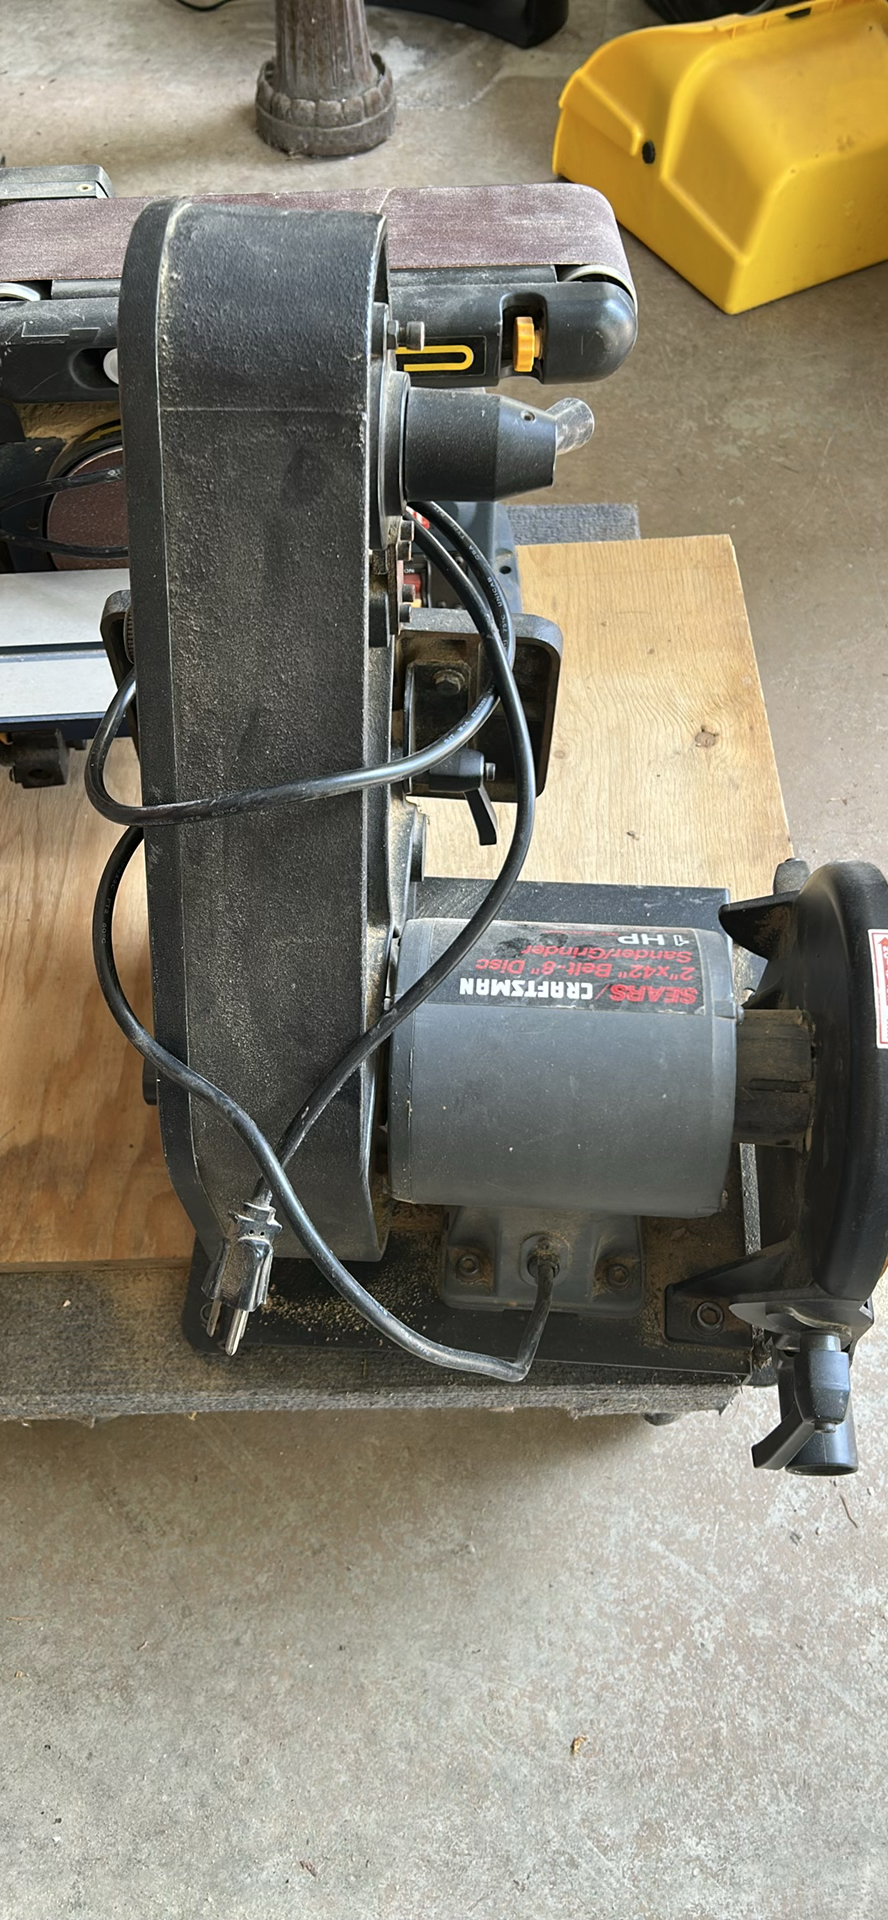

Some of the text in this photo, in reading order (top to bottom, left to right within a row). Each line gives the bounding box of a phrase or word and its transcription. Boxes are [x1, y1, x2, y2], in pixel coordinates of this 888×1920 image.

[487, 576, 503, 608] UNICAB
[617, 933, 690, 947] 1 HP
[521, 943, 693, 963] Sander/Grinder
[475, 957, 696, 982] 2"x42" Belt-8" Disc
